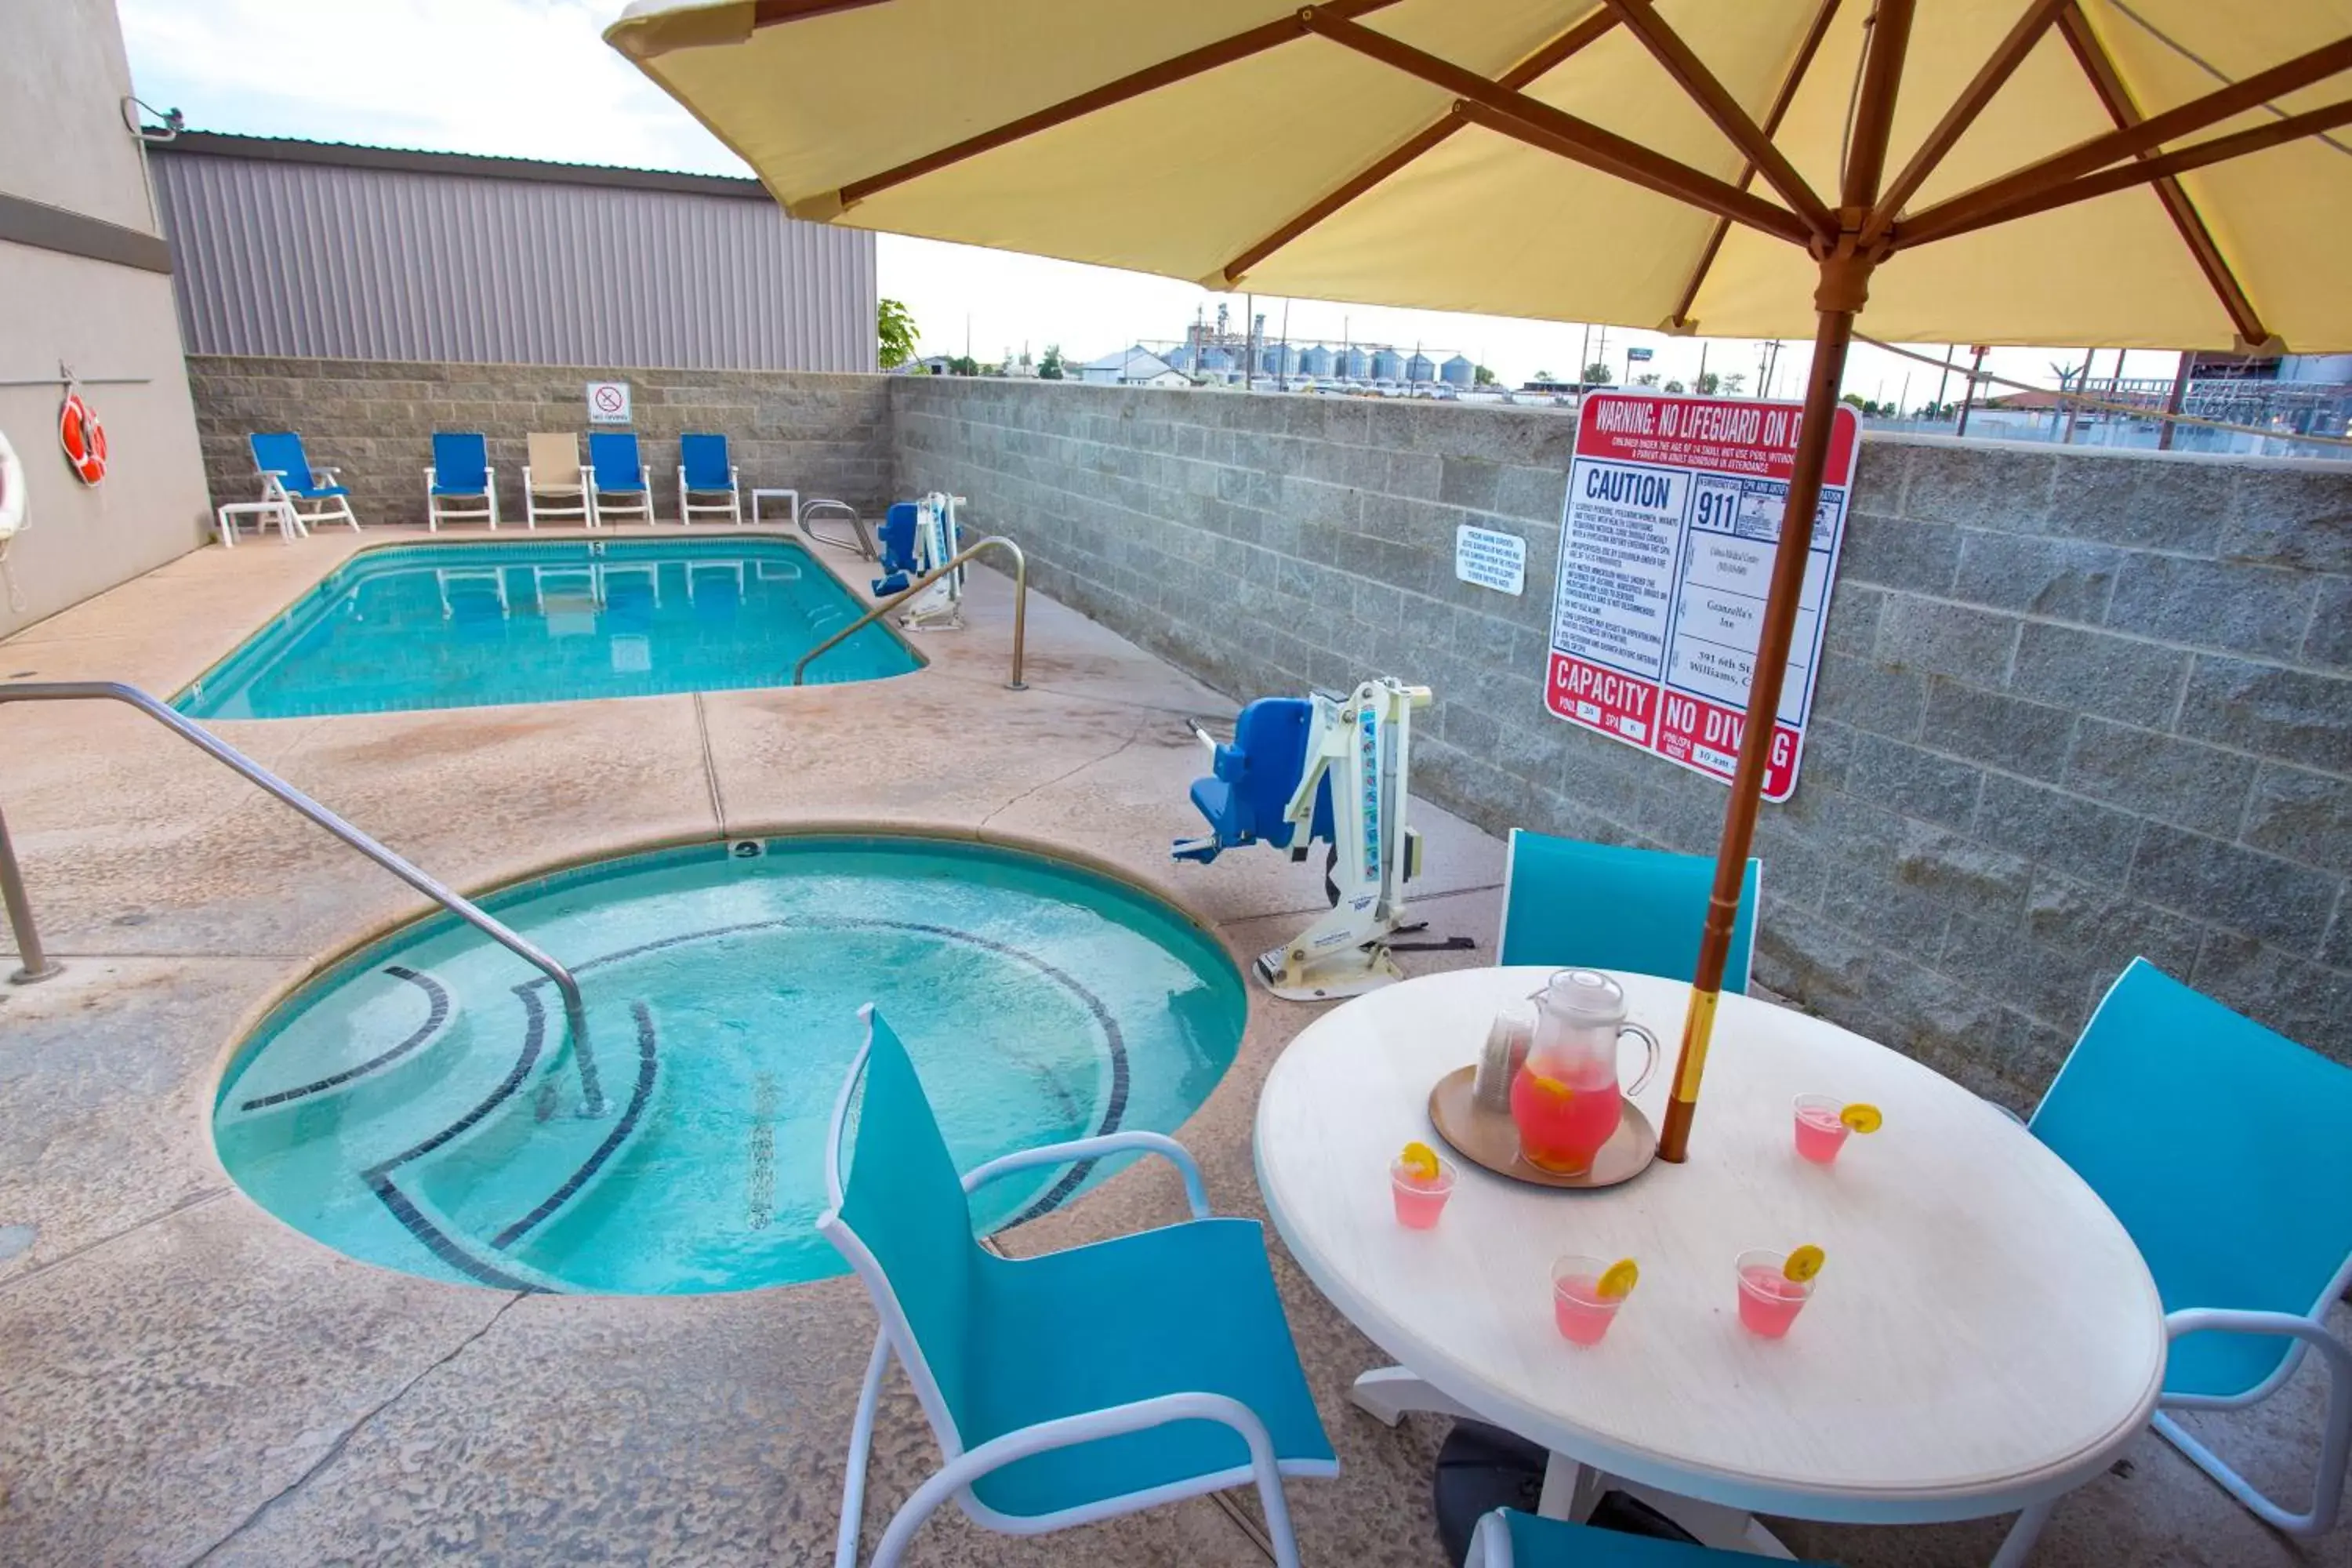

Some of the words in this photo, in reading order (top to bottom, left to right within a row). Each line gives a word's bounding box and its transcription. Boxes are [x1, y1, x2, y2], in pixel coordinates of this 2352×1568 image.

[1596, 399, 1655, 434] WARNING:
[1658, 404, 1679, 437] NO
[1683, 405, 1760, 443] LIFEGUARD
[1764, 410, 1788, 447] ON
[1586, 468, 1671, 510] CAUTION
[1697, 492, 1734, 528] 911
[1557, 660, 1649, 716] CAPACITY
[1690, 661, 1738, 684] Williams,
[1741, 677, 1751, 687] C
[1606, 713, 1619, 729] SPA
[1666, 696, 1697, 733] NO
